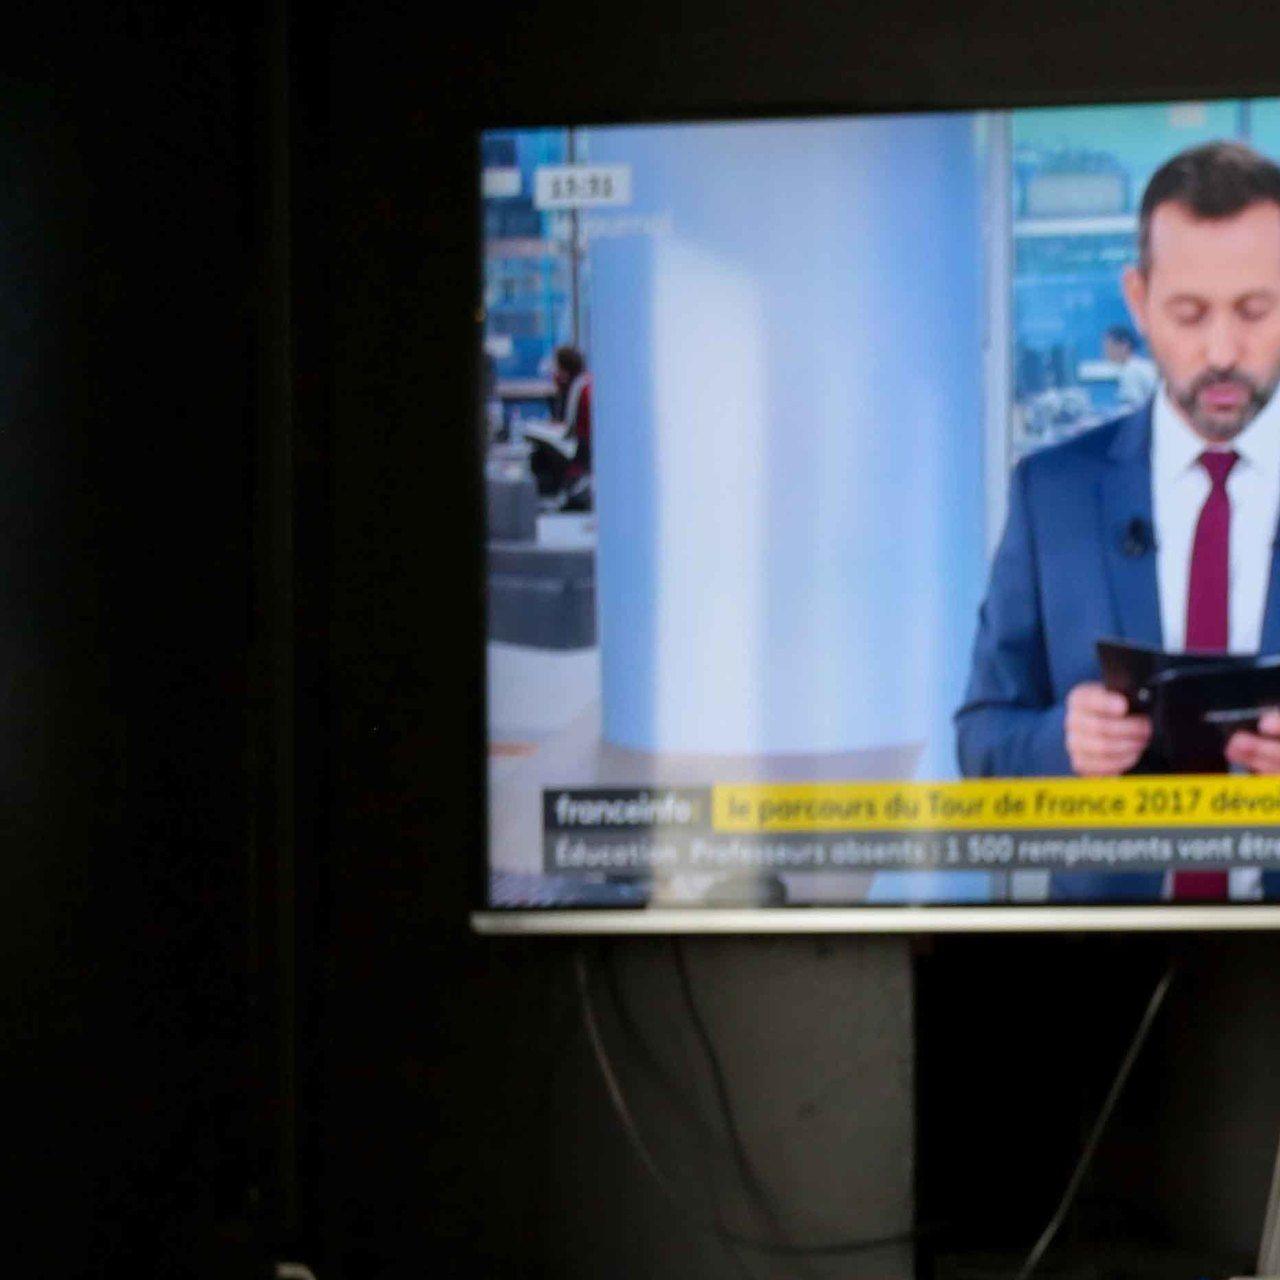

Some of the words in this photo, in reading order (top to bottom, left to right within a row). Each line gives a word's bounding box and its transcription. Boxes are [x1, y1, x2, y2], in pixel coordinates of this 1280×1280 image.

[759, 797, 877, 825] parcours
[884, 793, 919, 819] du
[929, 791, 985, 817] Tour
[994, 790, 1026, 815] de
[1035, 789, 1127, 814] France
[1135, 787, 1202, 814] 2017
[966, 835, 1015, 863] 500
[1018, 834, 1172, 866] remplaçants
[1177, 836, 1234, 861] vont
